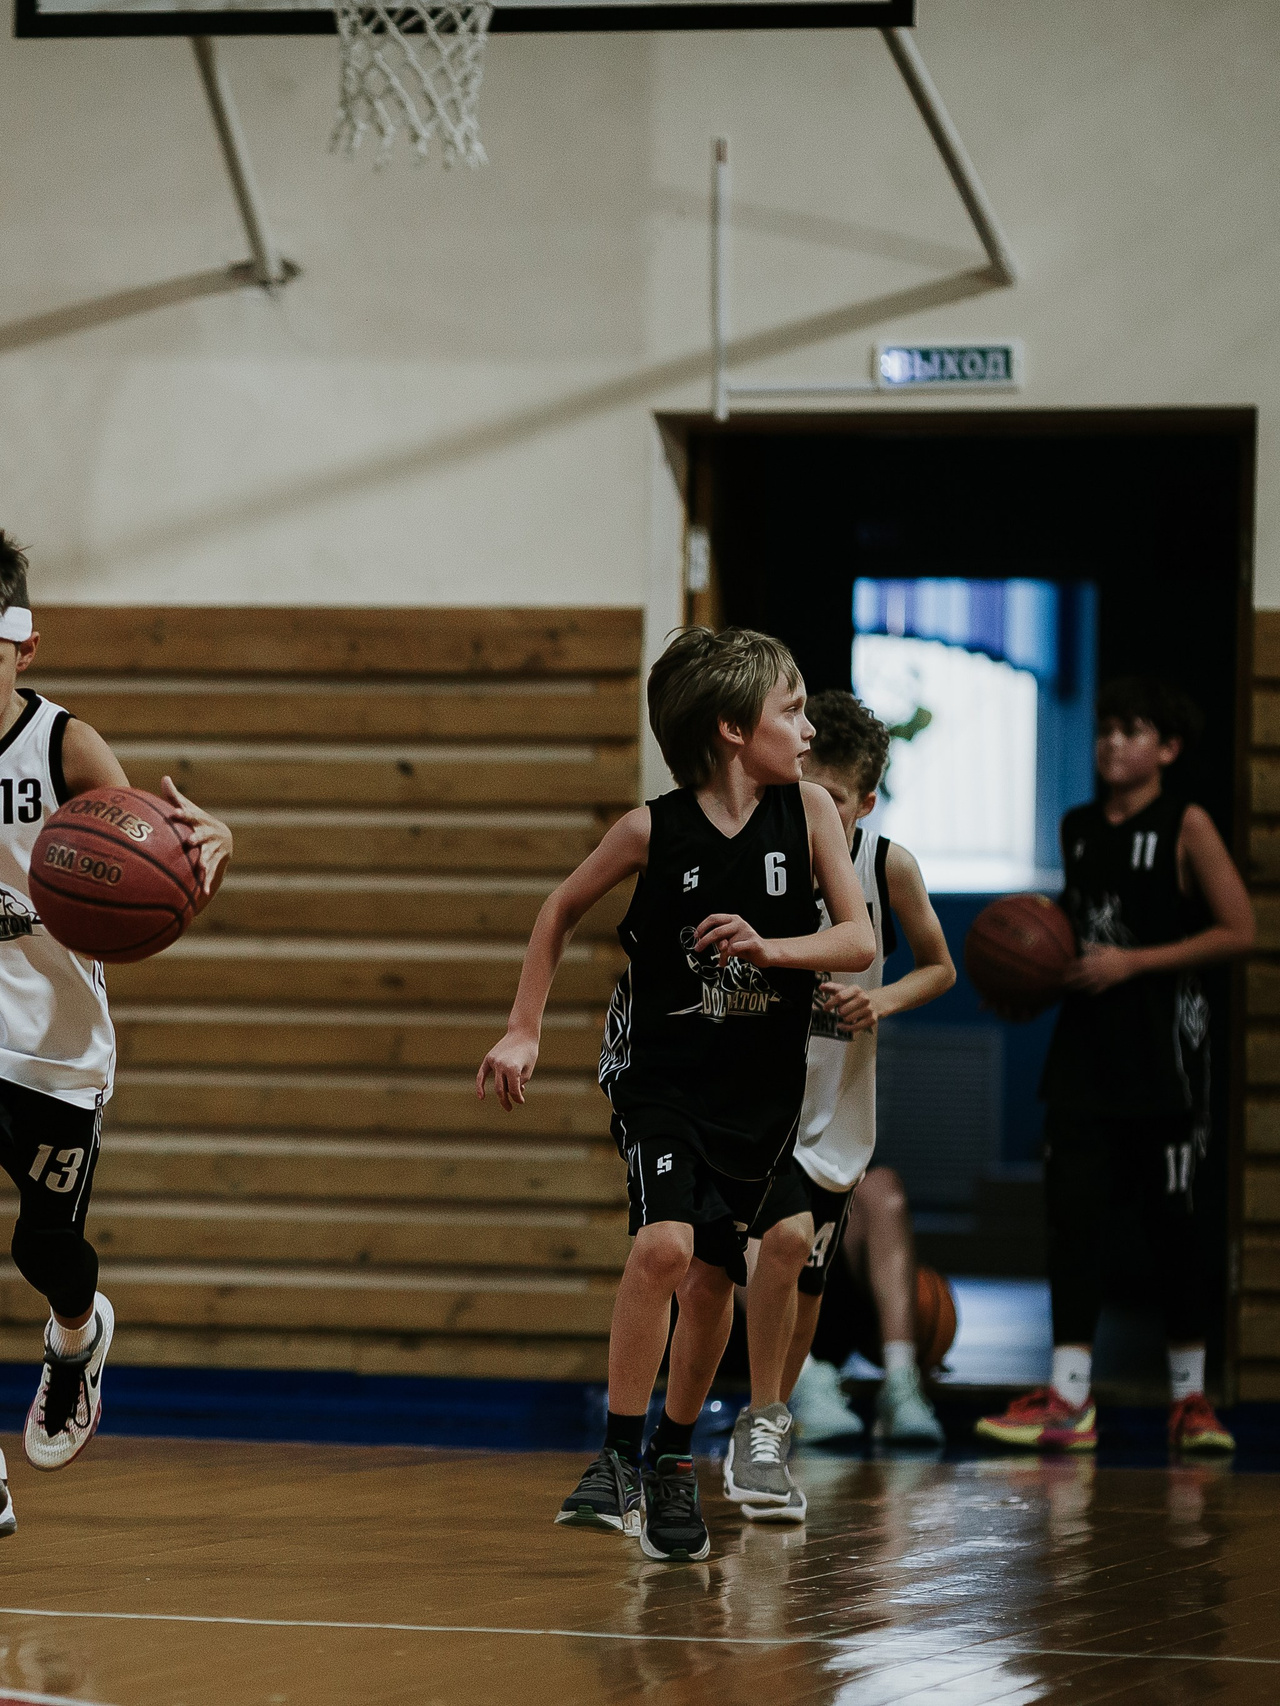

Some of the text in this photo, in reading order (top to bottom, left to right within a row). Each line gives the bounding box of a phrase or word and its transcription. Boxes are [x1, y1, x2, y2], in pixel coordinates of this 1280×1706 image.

[0, 778, 42, 825] 13
[63, 797, 154, 842] ORRES
[44, 842, 77, 873] BM
[78, 855, 123, 887] 900
[1130, 830, 1159, 871] 11
[764, 851, 787, 897] 6
[28, 1143, 85, 1193] 13
[804, 1221, 836, 1268] 4
